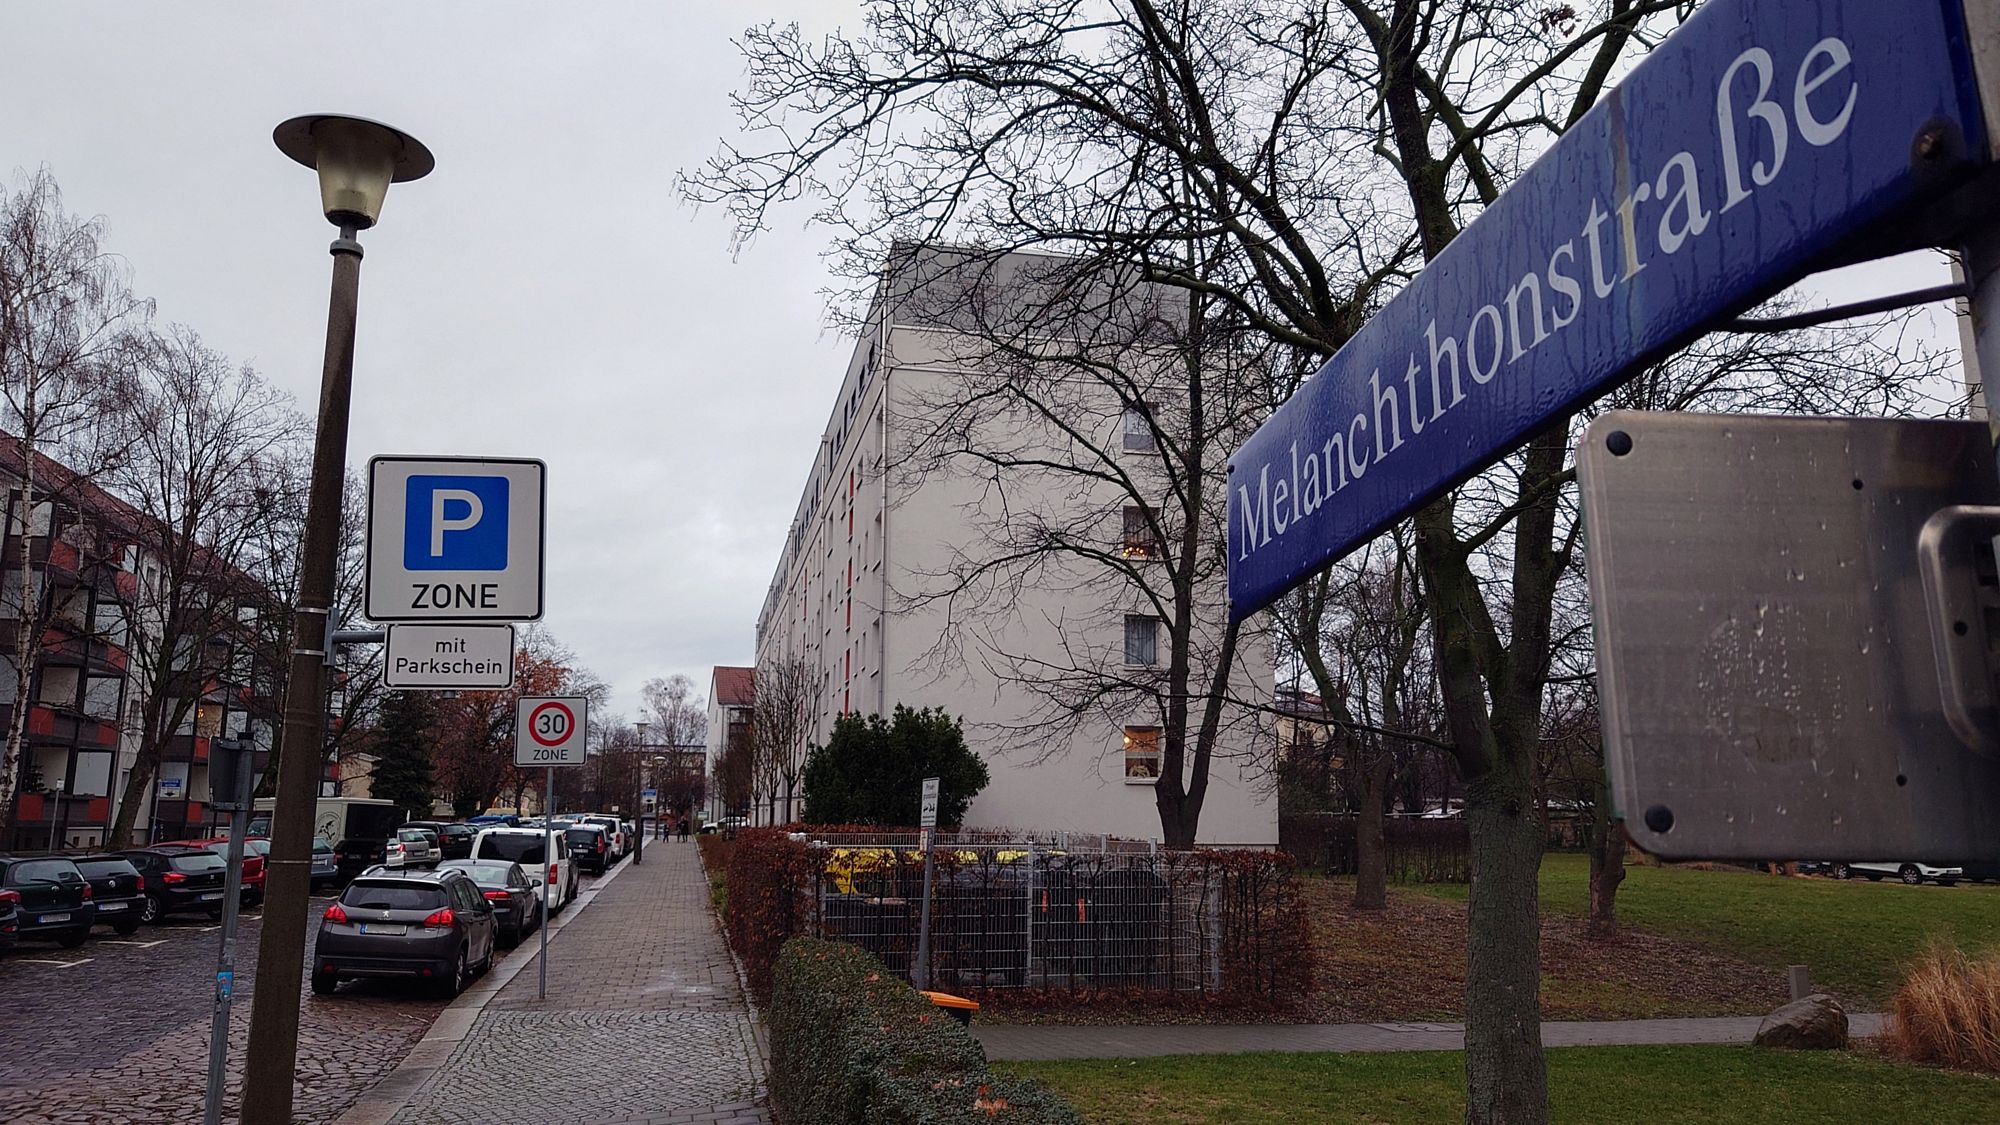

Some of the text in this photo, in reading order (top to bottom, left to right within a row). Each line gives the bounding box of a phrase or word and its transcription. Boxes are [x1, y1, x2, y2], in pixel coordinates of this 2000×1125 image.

[1238, 36, 1858, 562] Melanchthonstraße
[430, 489, 484, 557] P
[411, 584, 498, 609] ZONE
[435, 638, 466, 653] mit
[395, 657, 502, 674] Parkschein
[538, 714, 566, 734] 30
[533, 749, 568, 761] ZONE
